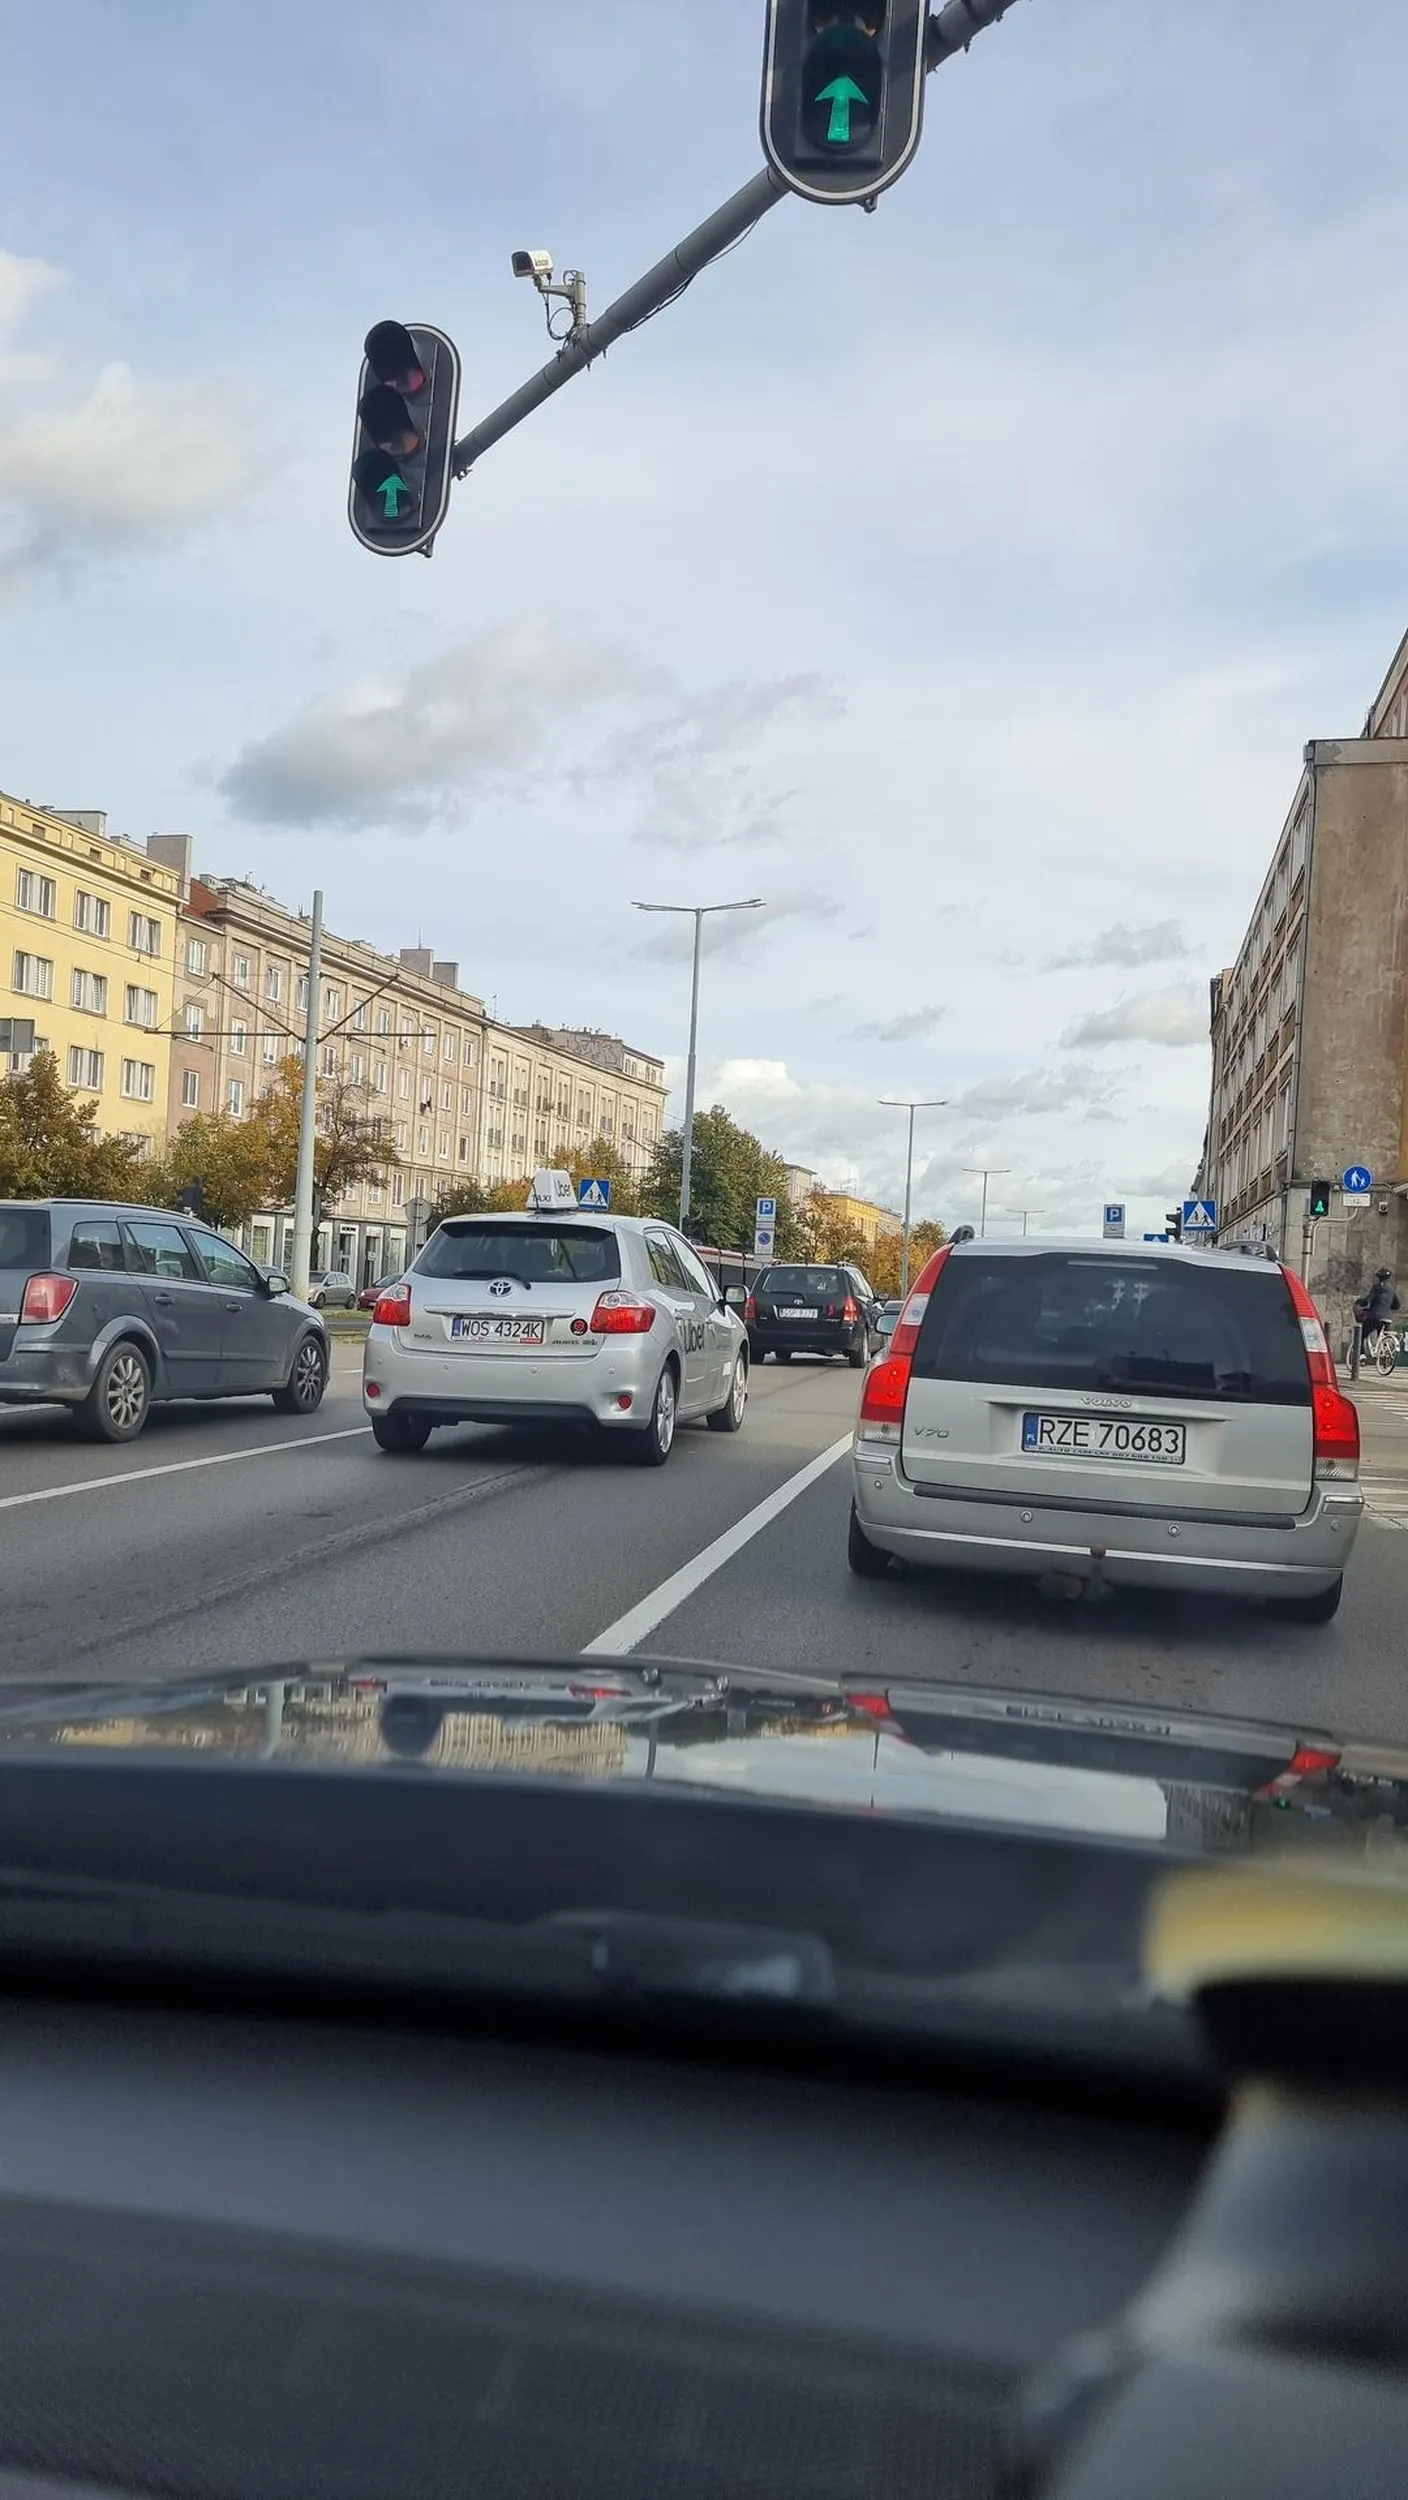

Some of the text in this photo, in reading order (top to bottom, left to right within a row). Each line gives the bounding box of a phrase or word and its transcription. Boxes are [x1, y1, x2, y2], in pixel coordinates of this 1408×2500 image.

[553, 1179, 571, 1197] Uber
[531, 1194, 551, 1202] TAXI
[762, 1201, 771, 1213] P
[1110, 1209, 1119, 1221] P
[461, 1320, 541, 1339] WOS 4324K
[1080, 1397, 1133, 1409] VOLVO
[914, 1427, 950, 1439] V70
[1039, 1418, 1179, 1454] RZE 70683
